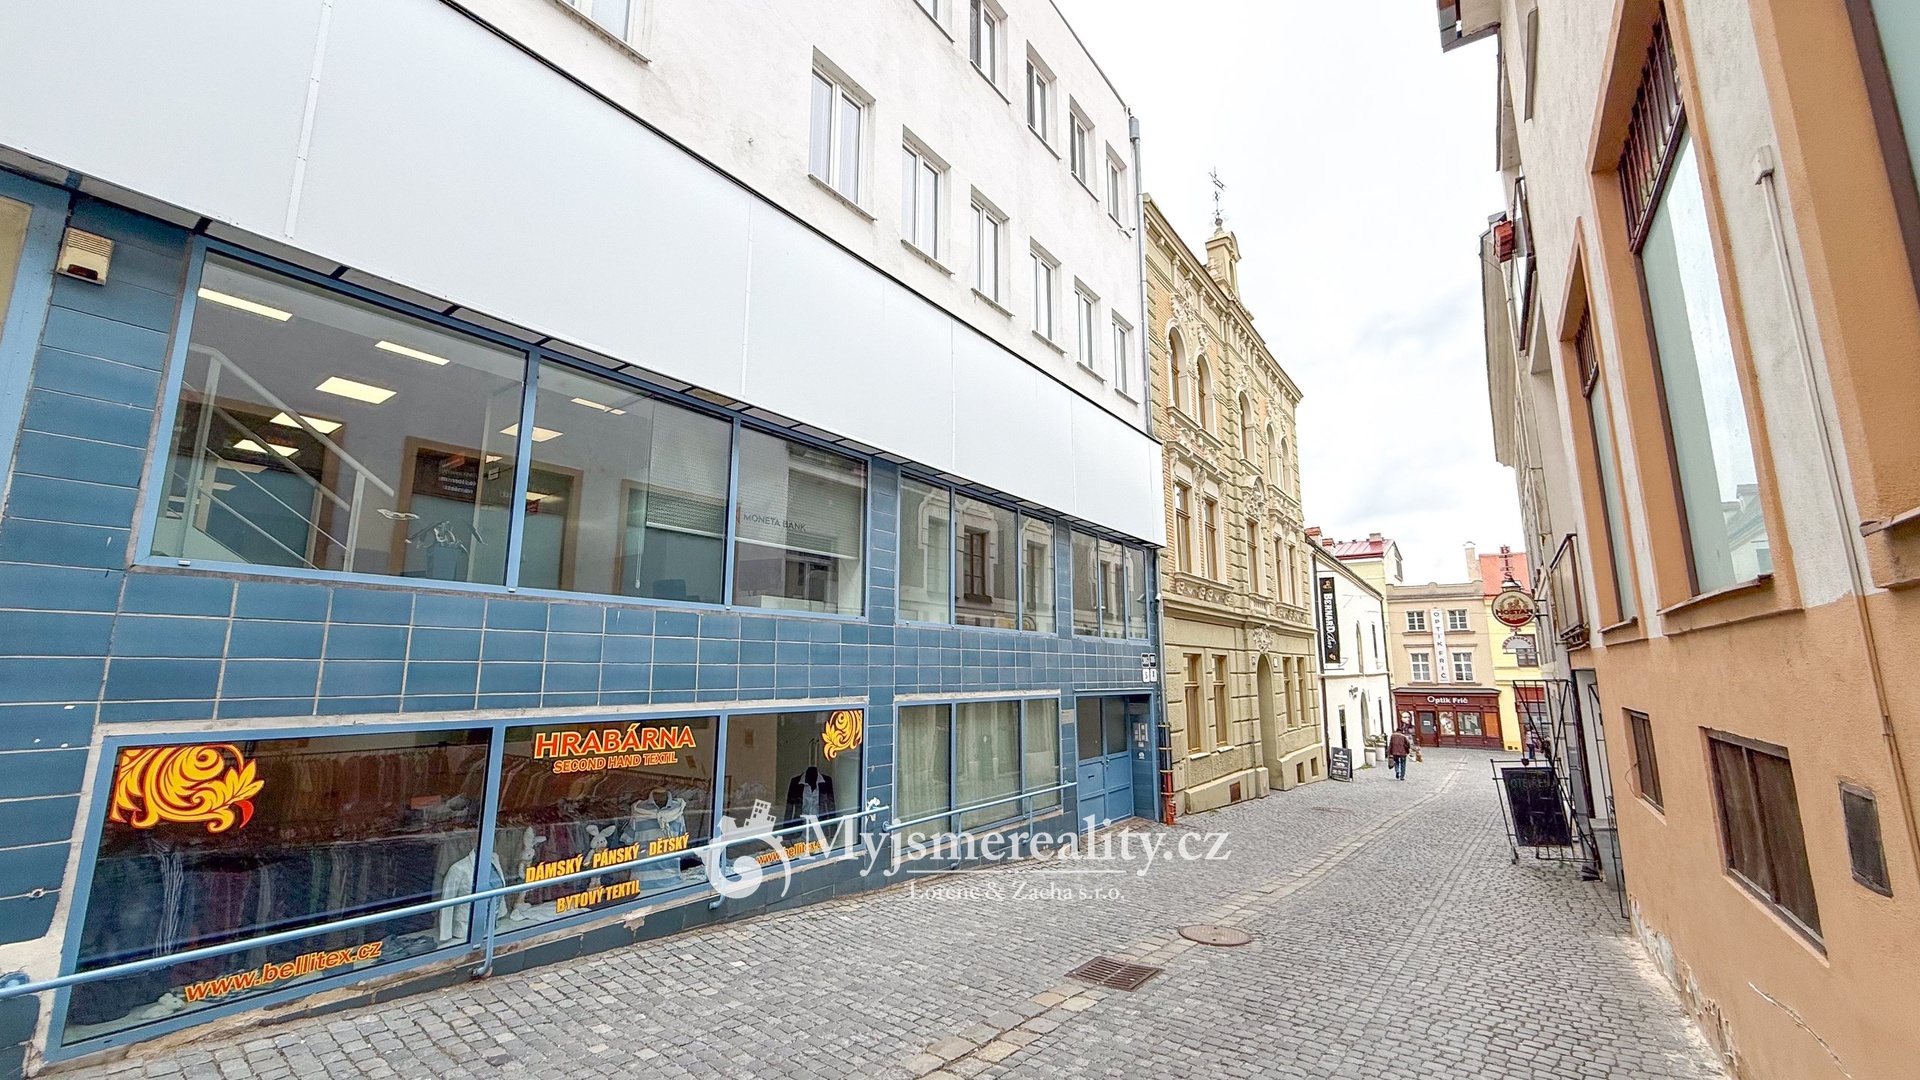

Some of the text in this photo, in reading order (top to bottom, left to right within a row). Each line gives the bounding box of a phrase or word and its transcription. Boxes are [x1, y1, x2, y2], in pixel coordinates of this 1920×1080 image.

[743, 513, 806, 532] MONETA BANK
[1323, 592, 1336, 632] BERNARD
[1495, 608, 1534, 616] HOSTAN
[1433, 611, 1443, 647] OPTIK
[1427, 695, 1451, 704] Optik
[533, 722, 697, 759] HRABÁRNA
[552, 751, 678, 774] SECOND HAND TEXTIL
[525, 853, 585, 884] DÁMSKÝ
[592, 842, 641, 869] PÁNSKÝ
[648, 832, 690, 856] DĚTSKÝ
[555, 885, 604, 914] BYTOVÝ
[184, 941, 383, 1002] www.bellitex.cz
